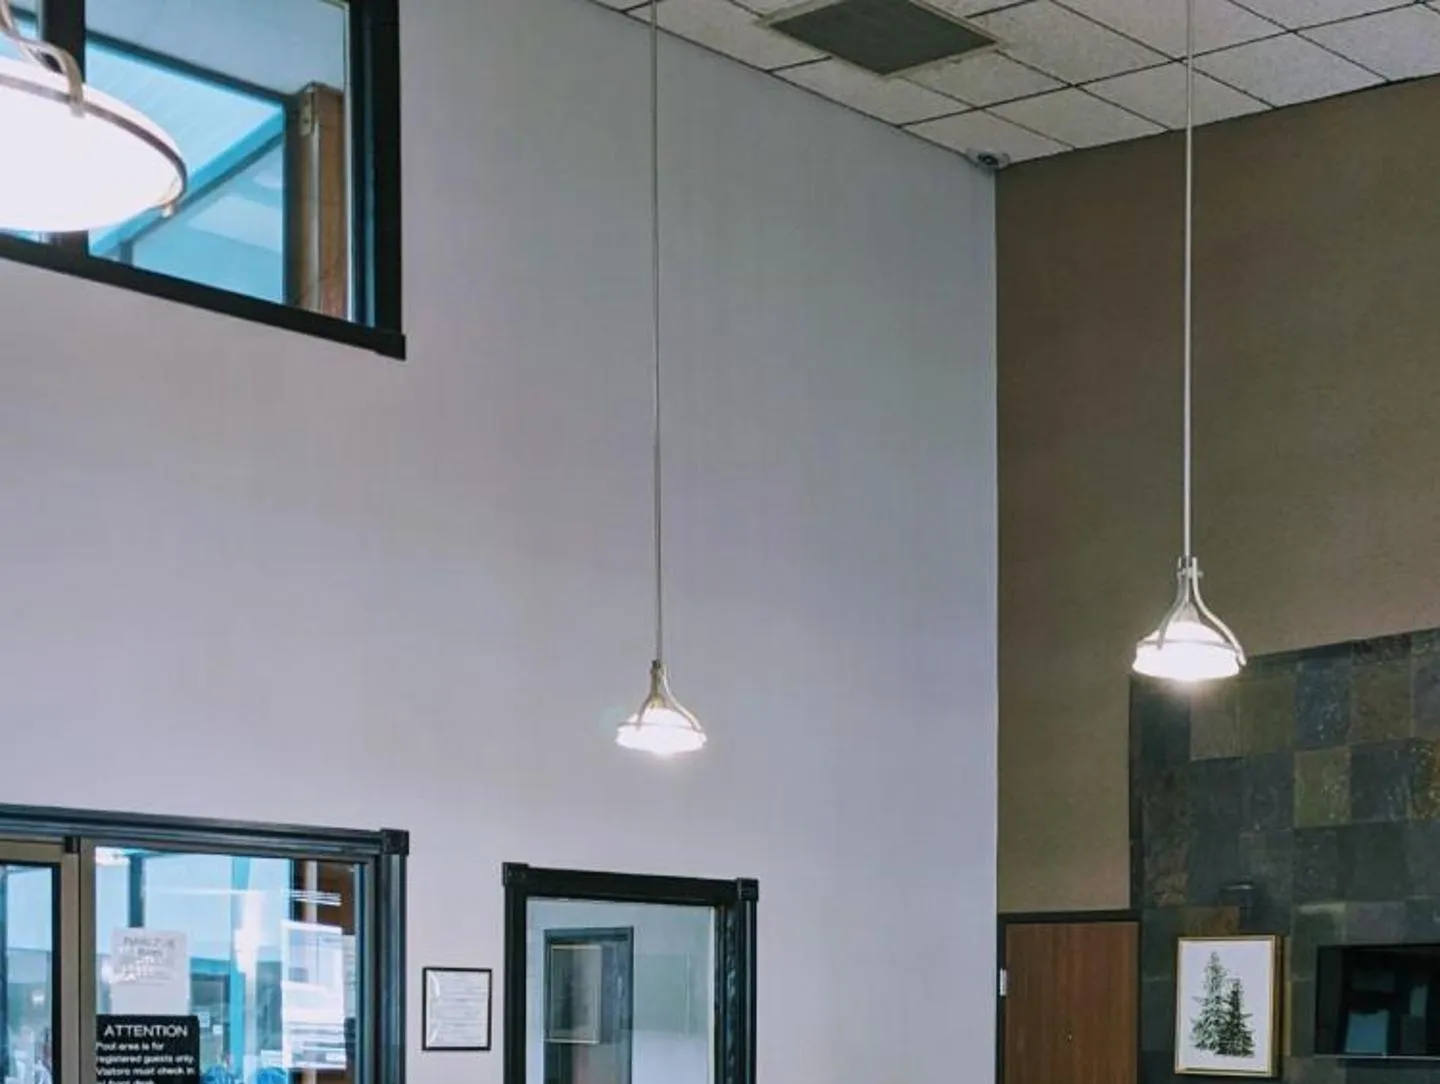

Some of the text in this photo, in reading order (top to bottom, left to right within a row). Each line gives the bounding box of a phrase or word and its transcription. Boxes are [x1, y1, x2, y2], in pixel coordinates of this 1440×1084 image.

[104, 1024, 188, 1038] ATTENTION
[96, 1041, 165, 1051] Pool area is for
[96, 1055, 142, 1065] registered
[143, 1055, 174, 1065] guests
[96, 1067, 131, 1076] Visitors
[132, 1067, 155, 1076] must
[157, 1066, 184, 1075] check
